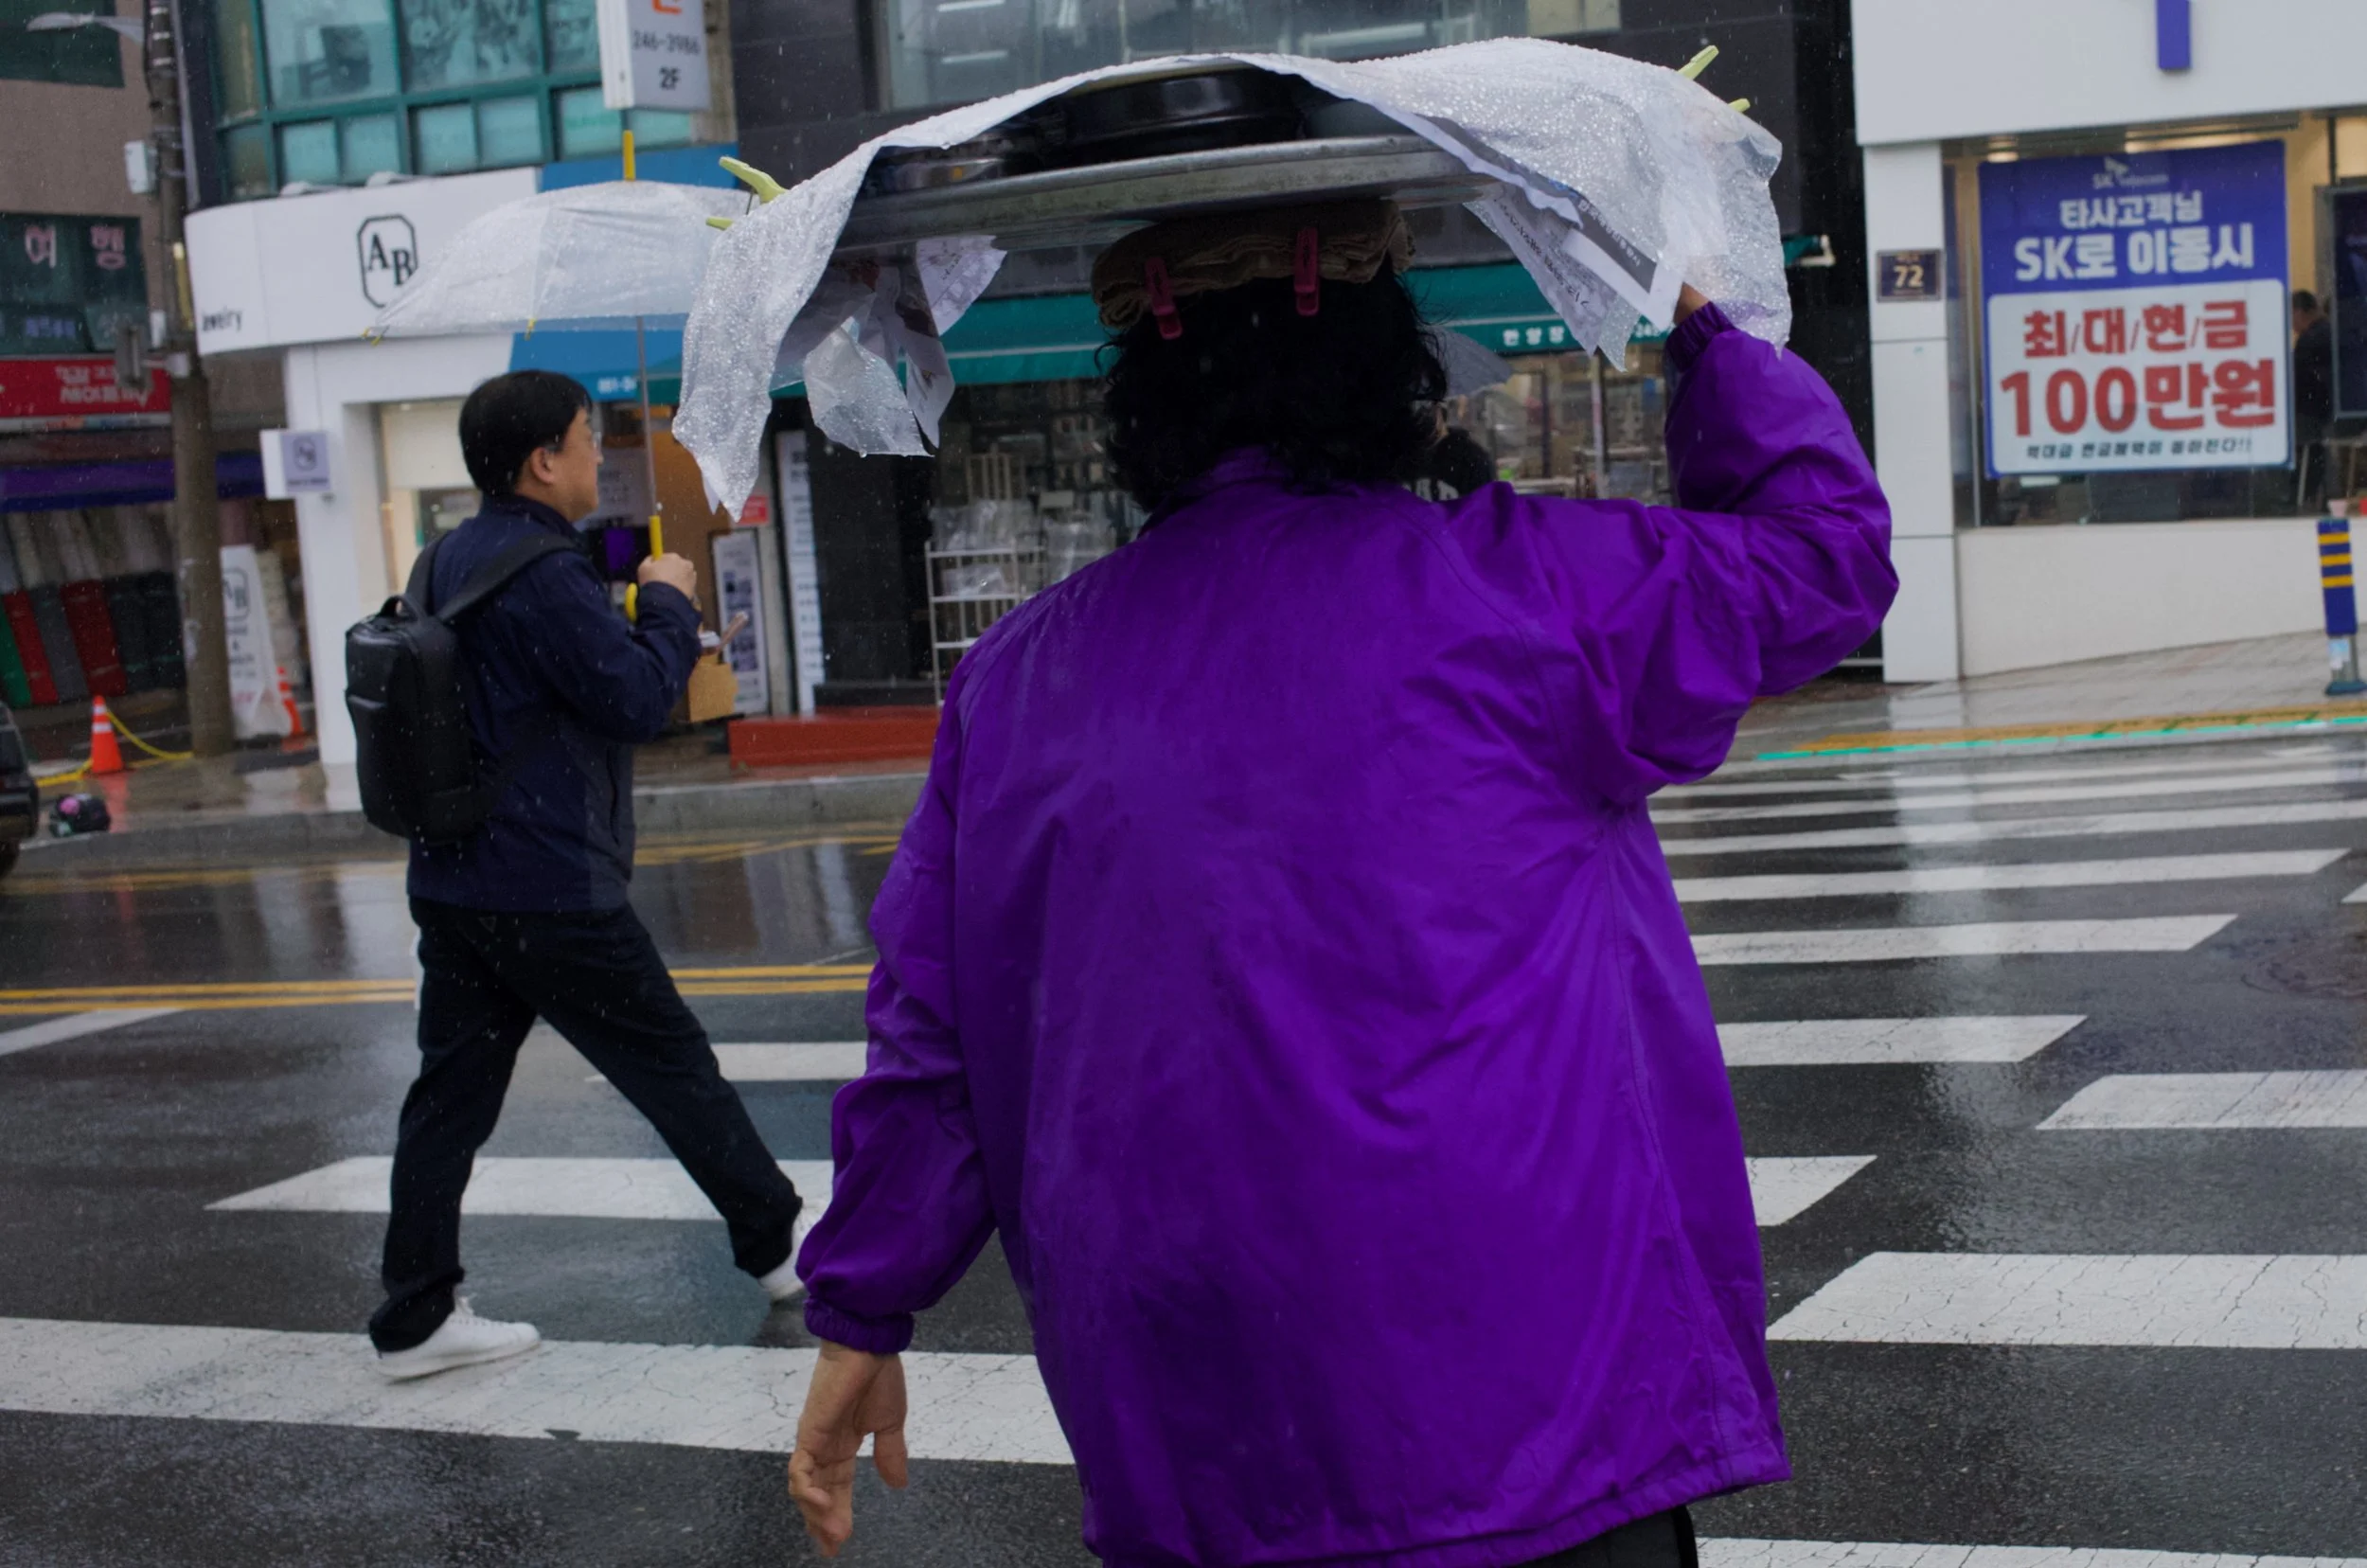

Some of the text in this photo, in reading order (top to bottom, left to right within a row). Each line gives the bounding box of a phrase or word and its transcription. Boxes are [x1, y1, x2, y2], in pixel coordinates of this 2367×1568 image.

[659, 66, 680, 91] 2F
[2059, 190, 2203, 229] 타사고객님
[2014, 223, 2254, 281] SK로 이동시
[1894, 265, 1924, 288] 72
[2024, 300, 2248, 359] 최/대/현/금
[2000, 358, 2276, 437] 100만원
